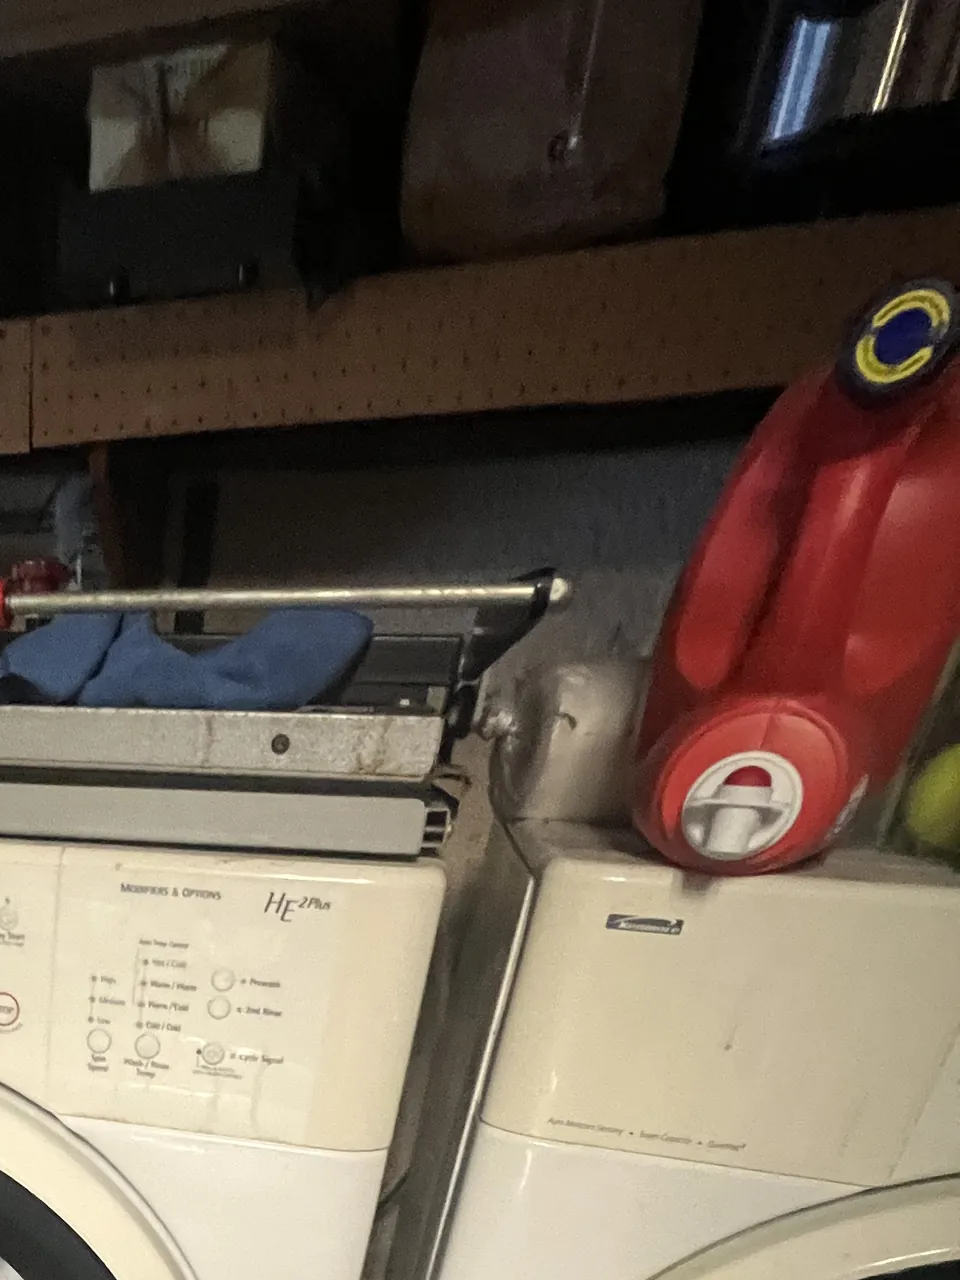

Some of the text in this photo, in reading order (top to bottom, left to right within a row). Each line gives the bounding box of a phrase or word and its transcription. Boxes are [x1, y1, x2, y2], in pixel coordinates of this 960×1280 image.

[121, 883, 222, 900] MODIFIERS & OPTIONS
